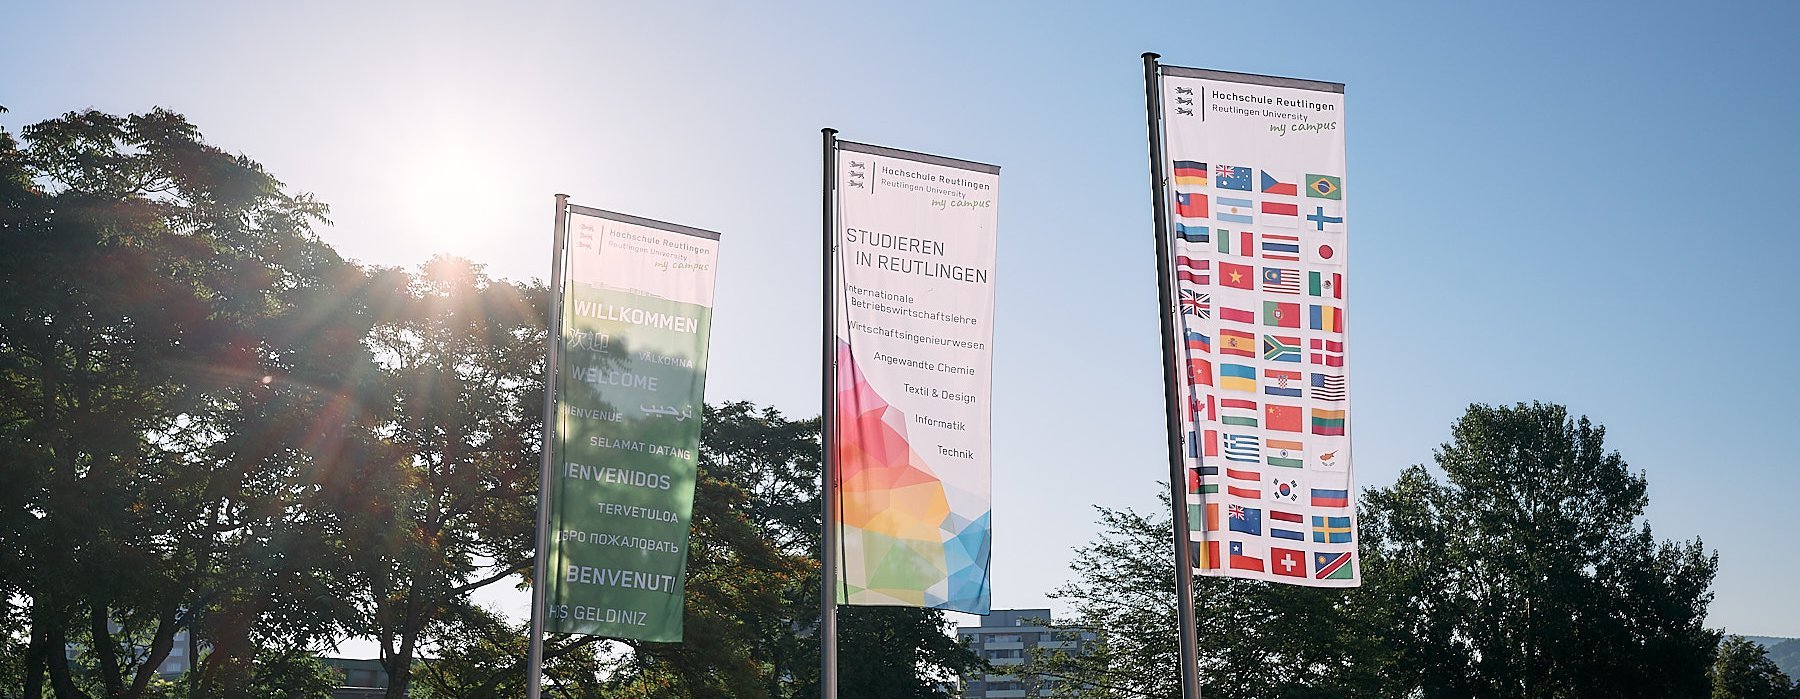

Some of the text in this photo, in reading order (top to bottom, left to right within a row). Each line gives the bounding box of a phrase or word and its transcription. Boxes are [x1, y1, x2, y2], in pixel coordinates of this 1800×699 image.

[1212, 90, 1335, 112] Hochschule Reutlingen
[1212, 104, 1308, 122] Reutlingen University
[1269, 121, 1337, 137] my campus
[881, 166, 990, 190] Hochschule Reutlingen
[881, 178, 967, 199] Reutlingen University
[931, 199, 991, 211] my campus
[608, 240, 688, 261] Reutlingen University
[609, 228, 710, 255] Hochschule Reutlingen
[846, 227, 945, 257] STUDIEREN
[655, 261, 709, 272] my campus
[856, 250, 988, 284] IN REUTLINGEN
[845, 282, 914, 304] Internationale
[574, 300, 698, 334] WILLKOMMEN
[851, 297, 977, 325] Betriebswirtschaftslehre
[567, 327, 609, 353] 欢迎
[848, 320, 985, 350] Wirtschaftsingenieurwesen
[639, 352, 693, 369] VÄLKOMNA
[873, 351, 976, 375] Angewandte Chemie
[571, 364, 658, 392] WELCOME
[903, 383, 976, 404] Textil & Design
[915, 414, 966, 431] Informatik
[590, 436, 691, 460] SELAMAT DATANG
[937, 444, 975, 460] Technik
[564, 462, 671, 490] IENVENIDOS
[598, 502, 679, 523] TERVETULOA
[590, 533, 679, 553] ПОЖАЛОВАТЬ
[566, 565, 676, 593] BENVENUTI
[574, 605, 648, 626] GELDINIZ
